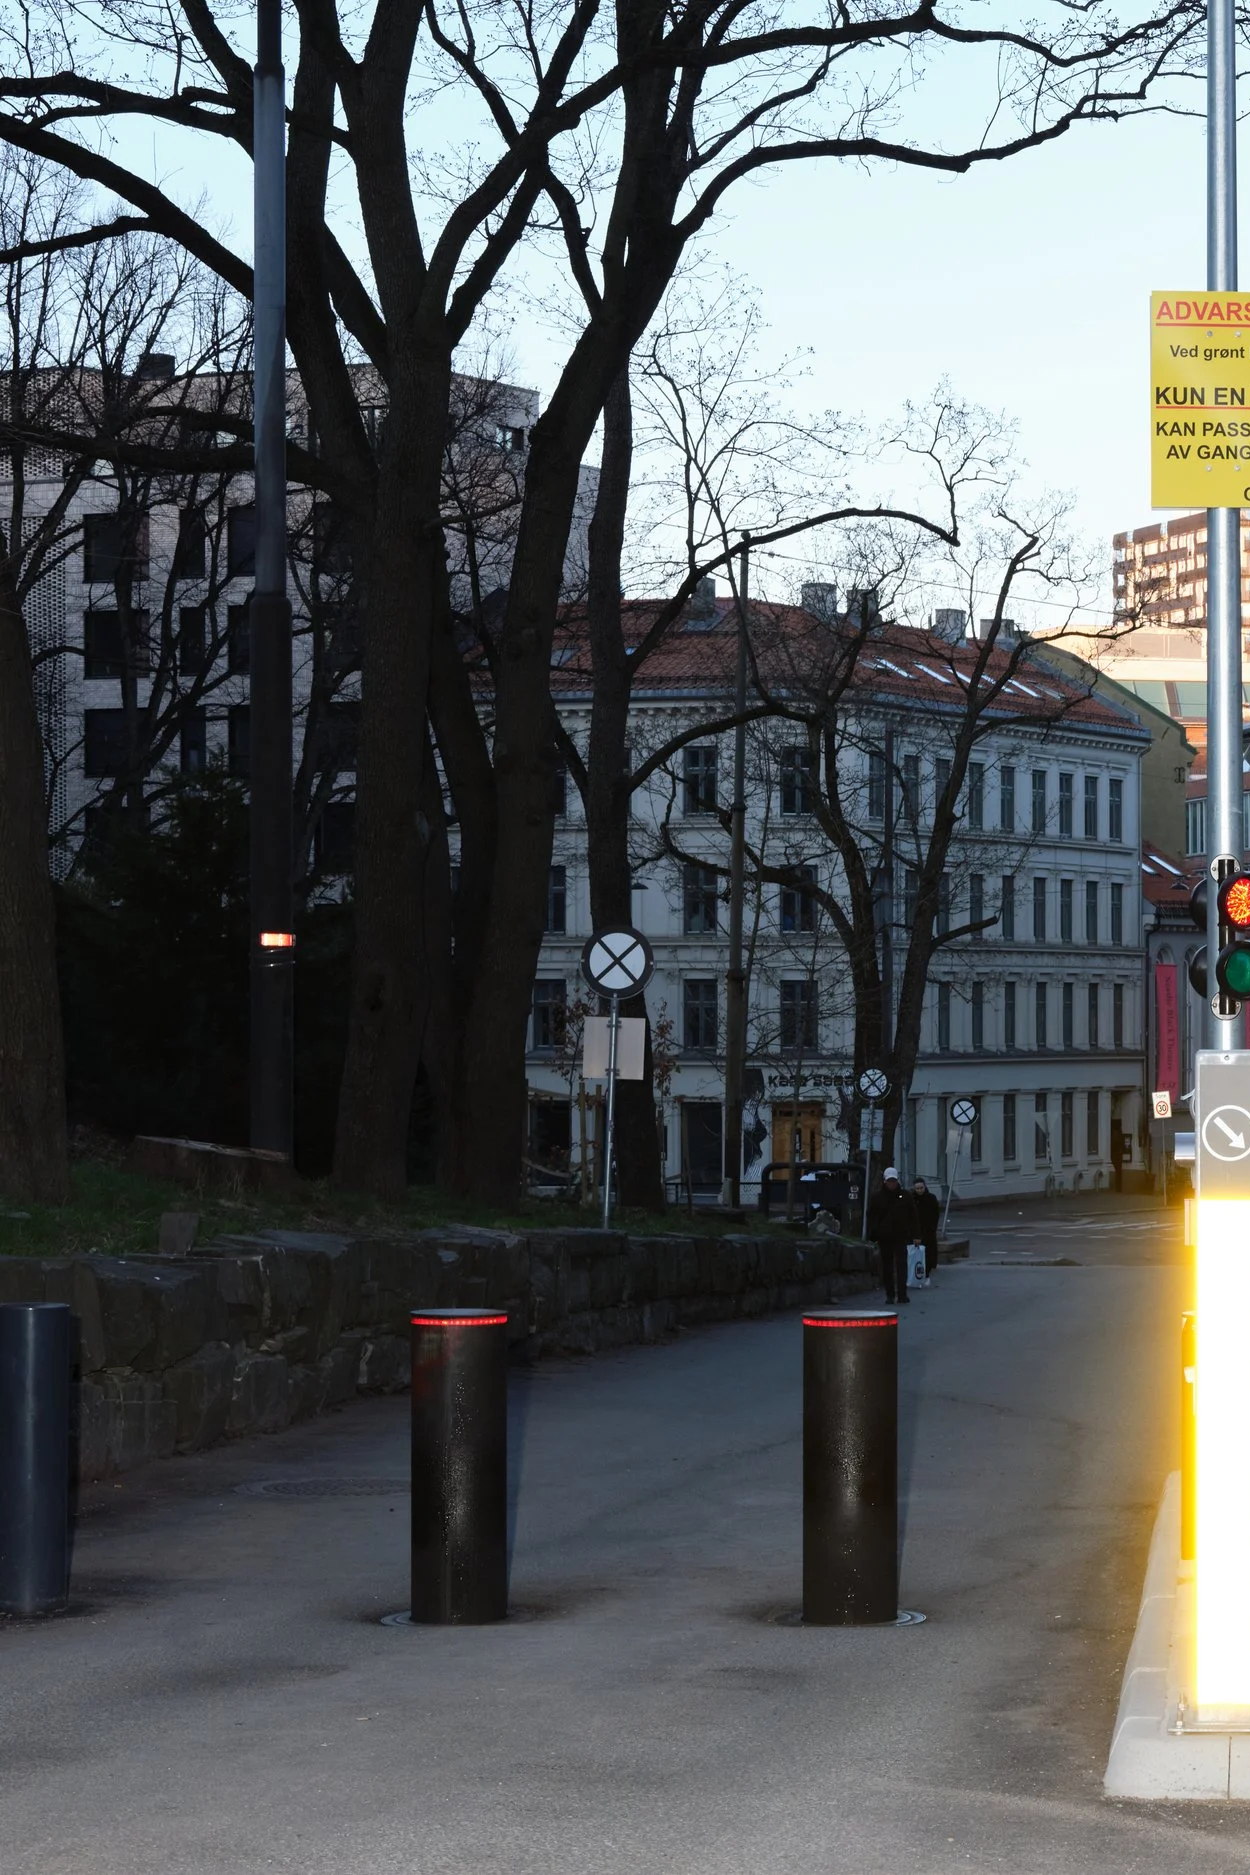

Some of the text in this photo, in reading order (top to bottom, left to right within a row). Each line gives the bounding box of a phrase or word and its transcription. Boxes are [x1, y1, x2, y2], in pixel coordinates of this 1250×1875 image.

[1169, 345, 1199, 358] Ved
[1203, 346, 1245, 361] grønt
[1155, 387, 1205, 405] KUN
[1214, 388, 1245, 406] EN
[1156, 422, 1196, 437] KAN
[1166, 445, 1192, 460] AV
[1166, 1009, 1175, 1034] Black
[1158, 1104, 1167, 1113] 30
